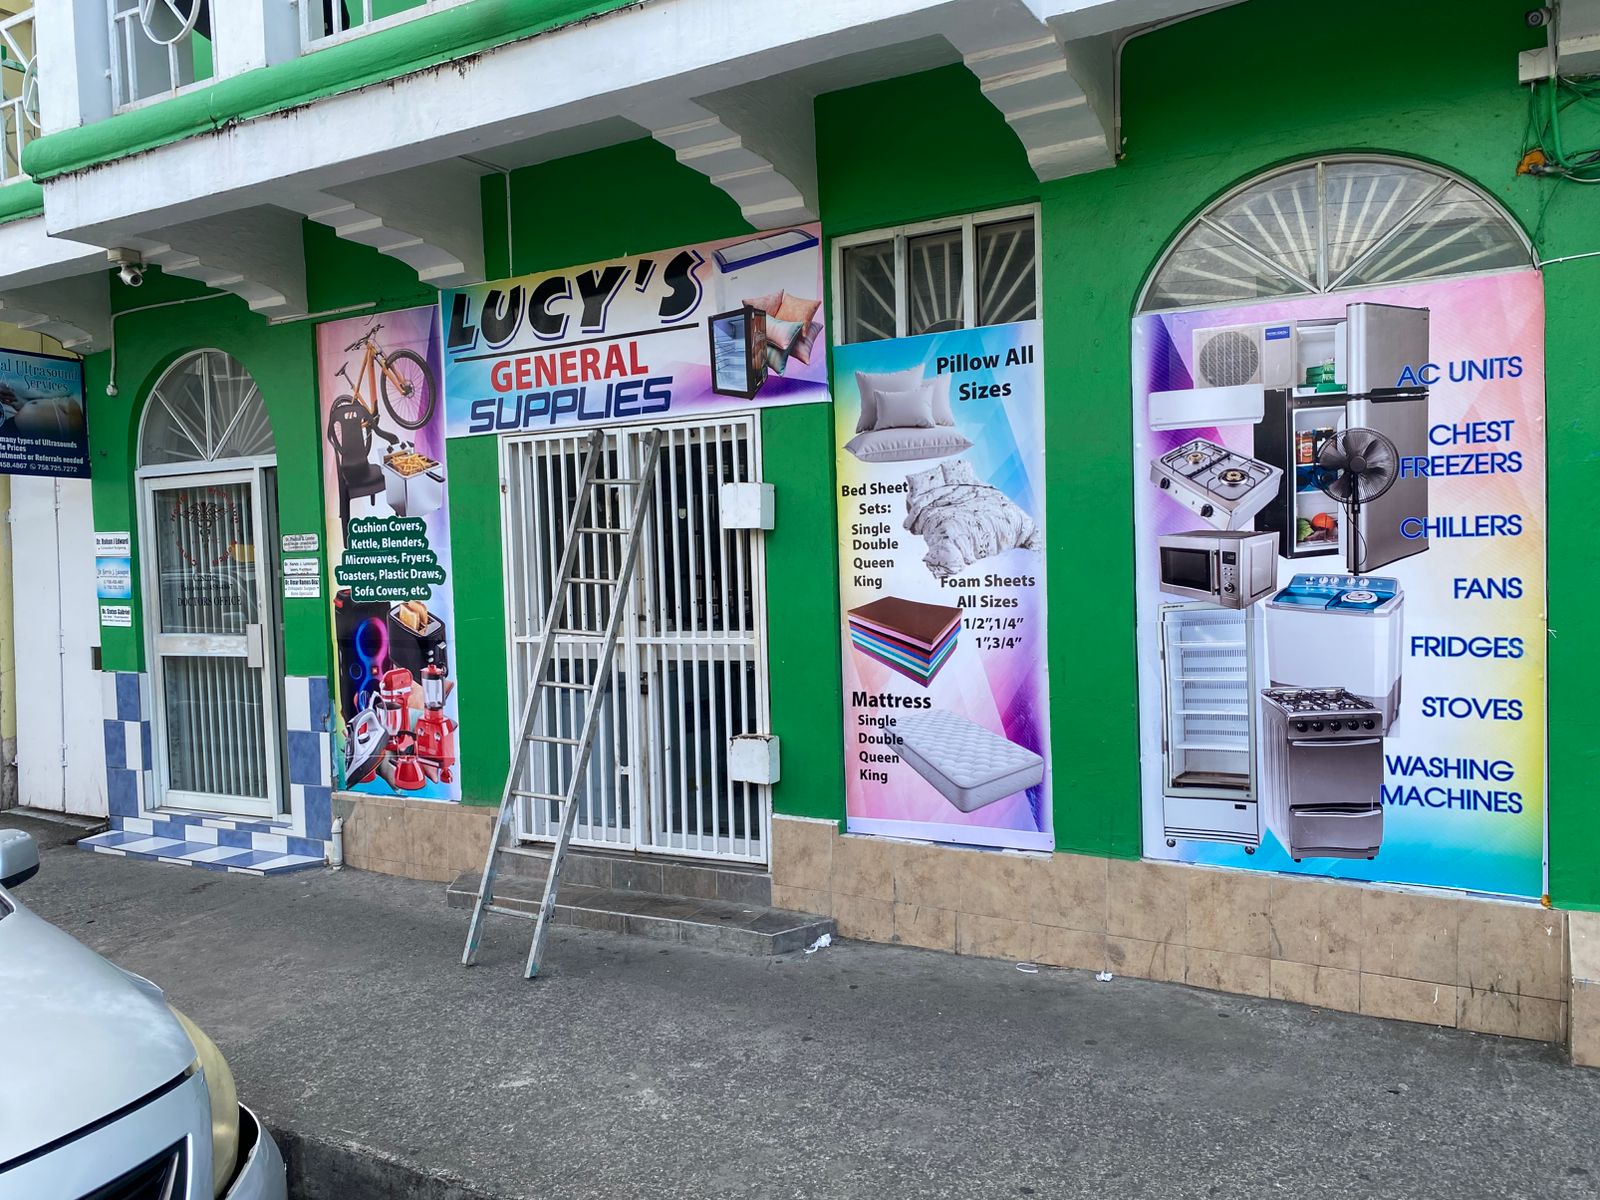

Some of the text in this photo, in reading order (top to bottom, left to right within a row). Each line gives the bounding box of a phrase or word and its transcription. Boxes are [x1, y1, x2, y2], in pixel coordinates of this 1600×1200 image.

[446, 249, 705, 354] LUCY'S
[490, 341, 649, 393] GENERAL
[936, 345, 1034, 375] Pillow All
[16, 360, 80, 381] Ultrasound
[1397, 356, 1523, 387] AC UNITS
[24, 376, 69, 391] Services
[958, 382, 1012, 401] Sizes
[469, 376, 674, 433] SUPPLIES
[1429, 420, 1515, 446] CHEST
[7, 443, 27, 452] Prices
[42, 439, 78, 448] Ultrasounds
[35, 454, 62, 462] Referrals
[1401, 451, 1523, 478] FREEZERS
[841, 482, 909, 497] Bed Sheet
[859, 502, 892, 515] Sets:
[352, 521, 423, 533] Cushion Covers,
[851, 523, 891, 537] Single
[1400, 514, 1523, 539] CHILLERS
[351, 537, 425, 549] Kettle, Blenders,
[852, 538, 899, 551] Double
[345, 552, 433, 565] Microwaves, Fryers,
[853, 557, 895, 570] Queen
[338, 568, 442, 581] Toasters, Plastic Draws,
[853, 575, 883, 589] King
[940, 574, 1036, 588] Foam Sheets
[354, 586, 428, 597] Sofa Covers, etc.
[1453, 577, 1523, 599] FANS
[178, 596, 242, 607] DOCTORS OFFICE
[957, 595, 1019, 608] All Sizes
[1411, 635, 1524, 659] FRIDGES
[851, 691, 932, 709] Mattress
[1421, 696, 1523, 721] STOVES
[858, 714, 897, 729] Single
[858, 732, 904, 745] Double
[859, 751, 900, 764] Queen
[1385, 754, 1515, 782] WASHING
[859, 769, 888, 784] King
[1380, 784, 1523, 814] MACHINES
